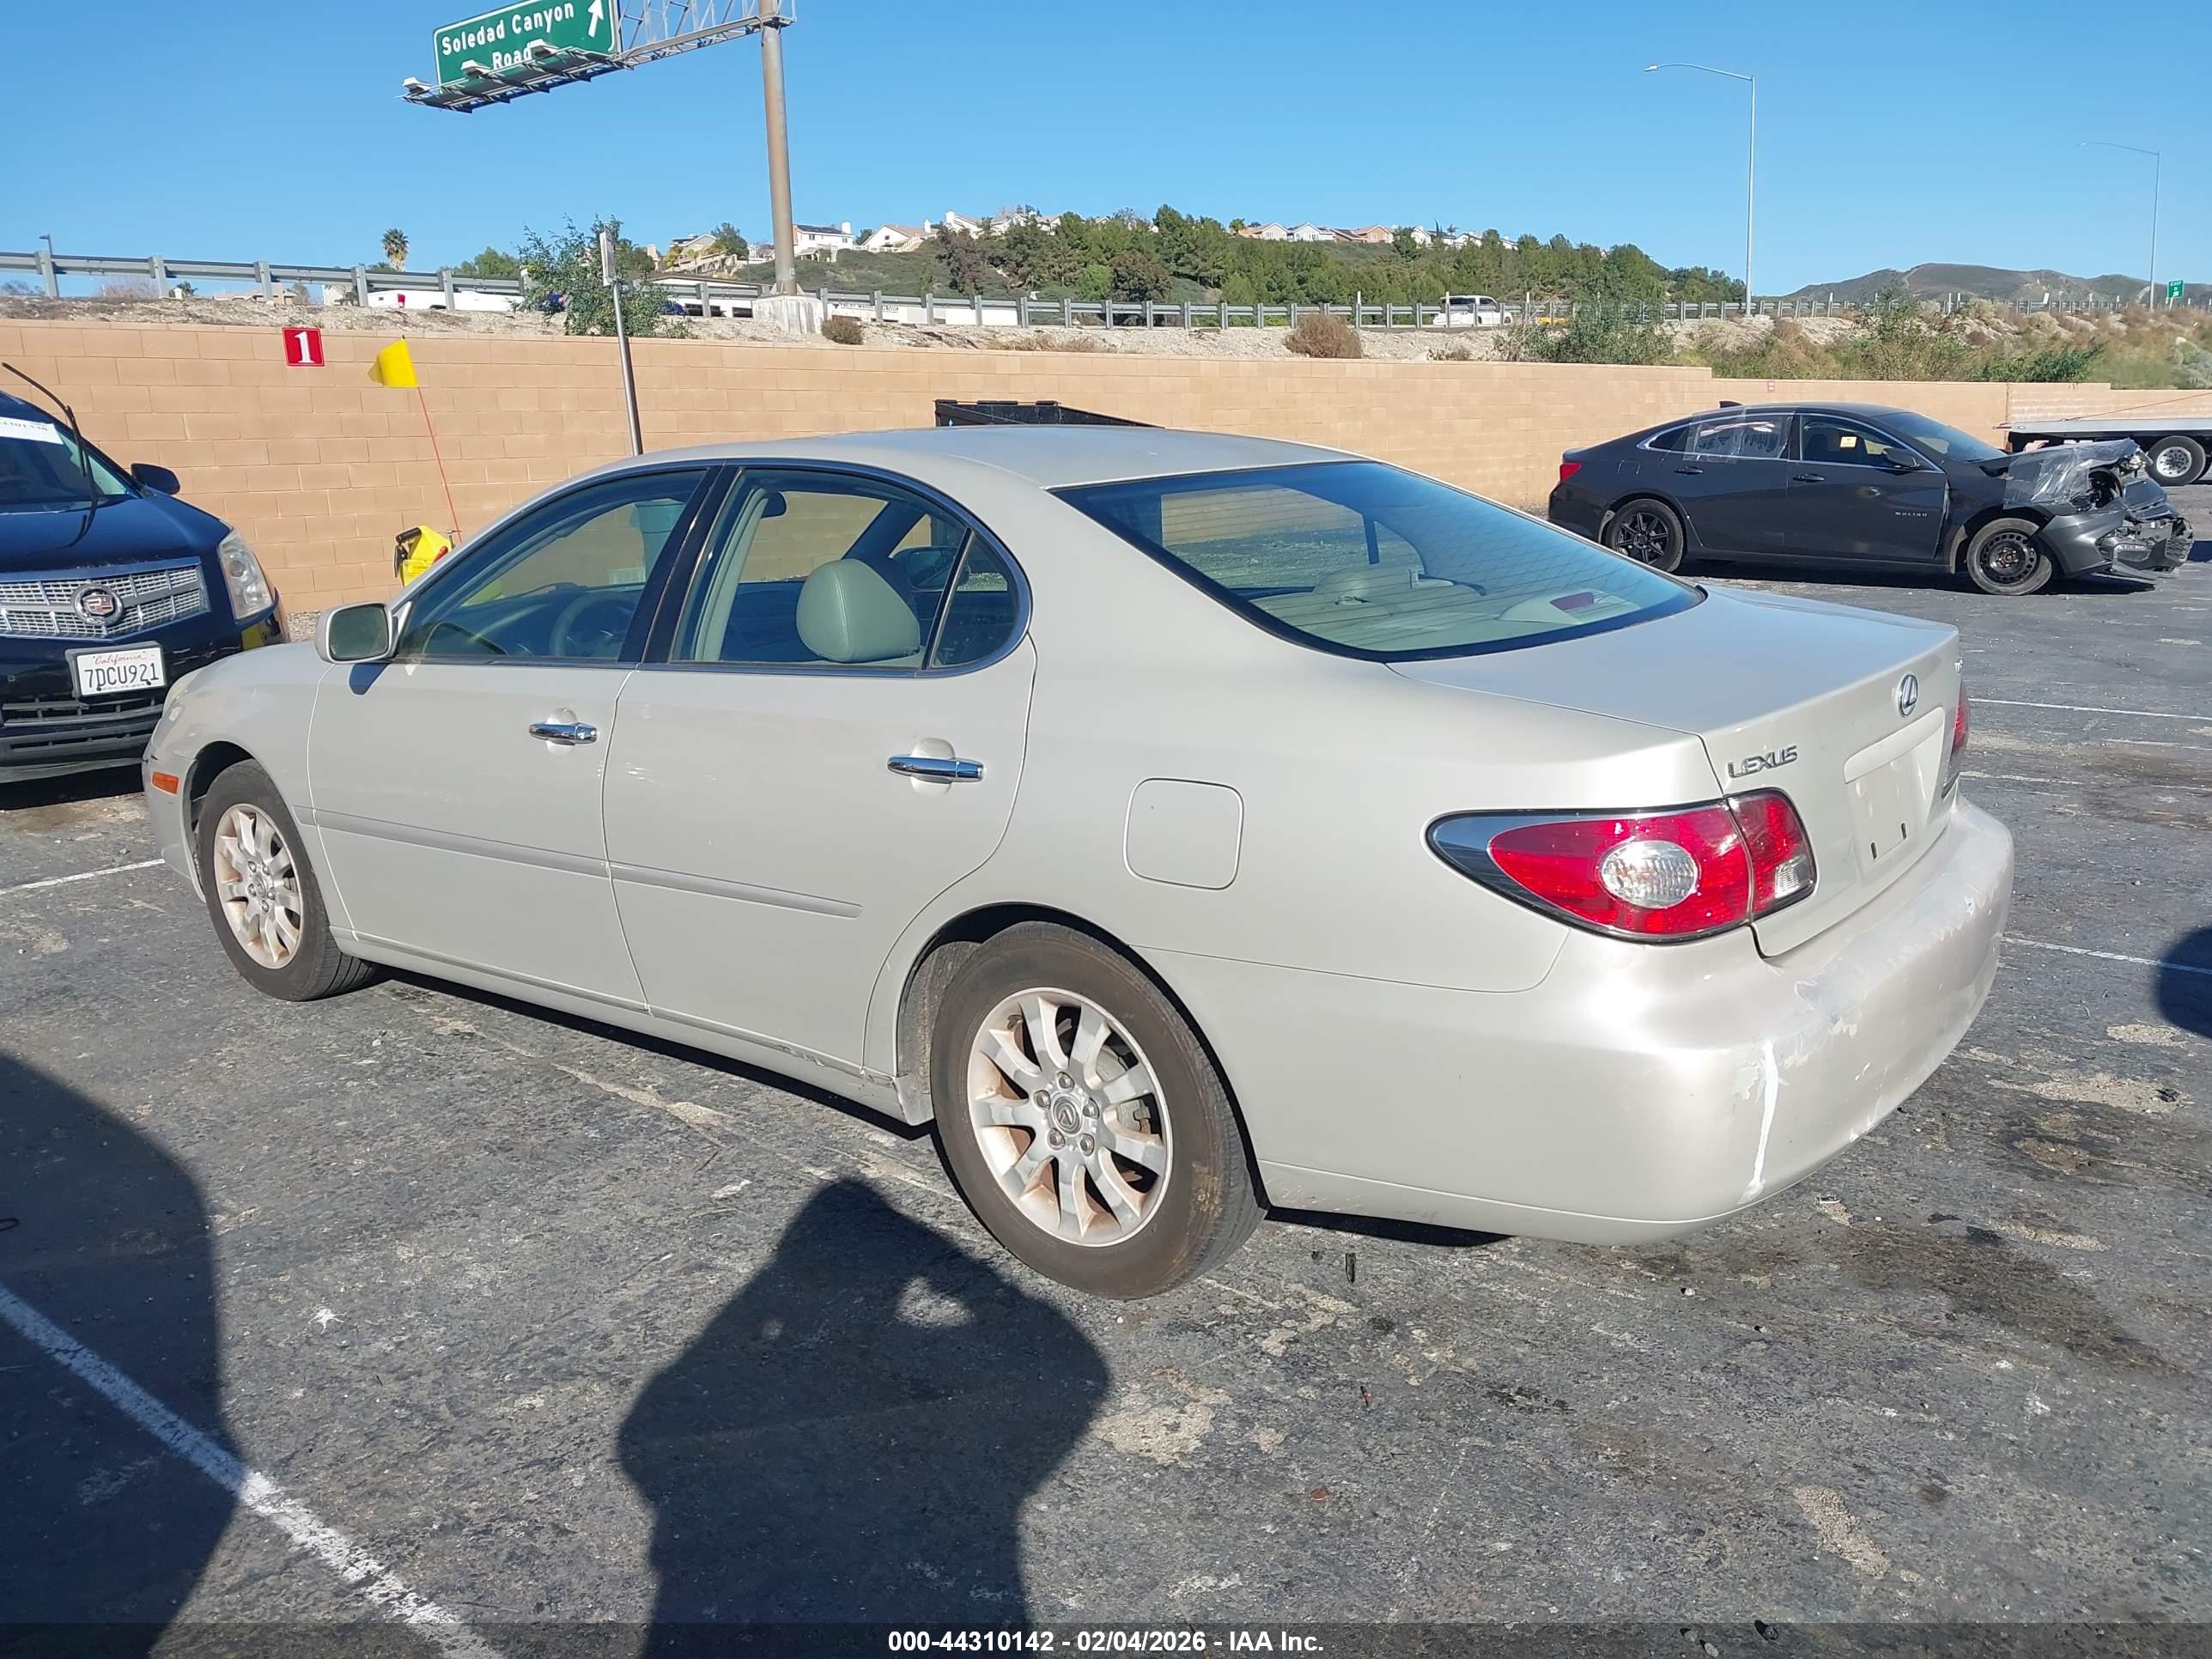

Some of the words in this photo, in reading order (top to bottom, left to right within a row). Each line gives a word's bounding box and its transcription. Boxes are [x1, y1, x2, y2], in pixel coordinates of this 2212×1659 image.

[441, 19, 506, 56] Soledad
[511, 3, 574, 34] Canyon
[491, 45, 532, 70] Road
[295, 331, 315, 363] 1
[94, 653, 147, 665] California
[83, 662, 160, 688] 7DCU921
[1727, 744, 1798, 779] LEXUS
